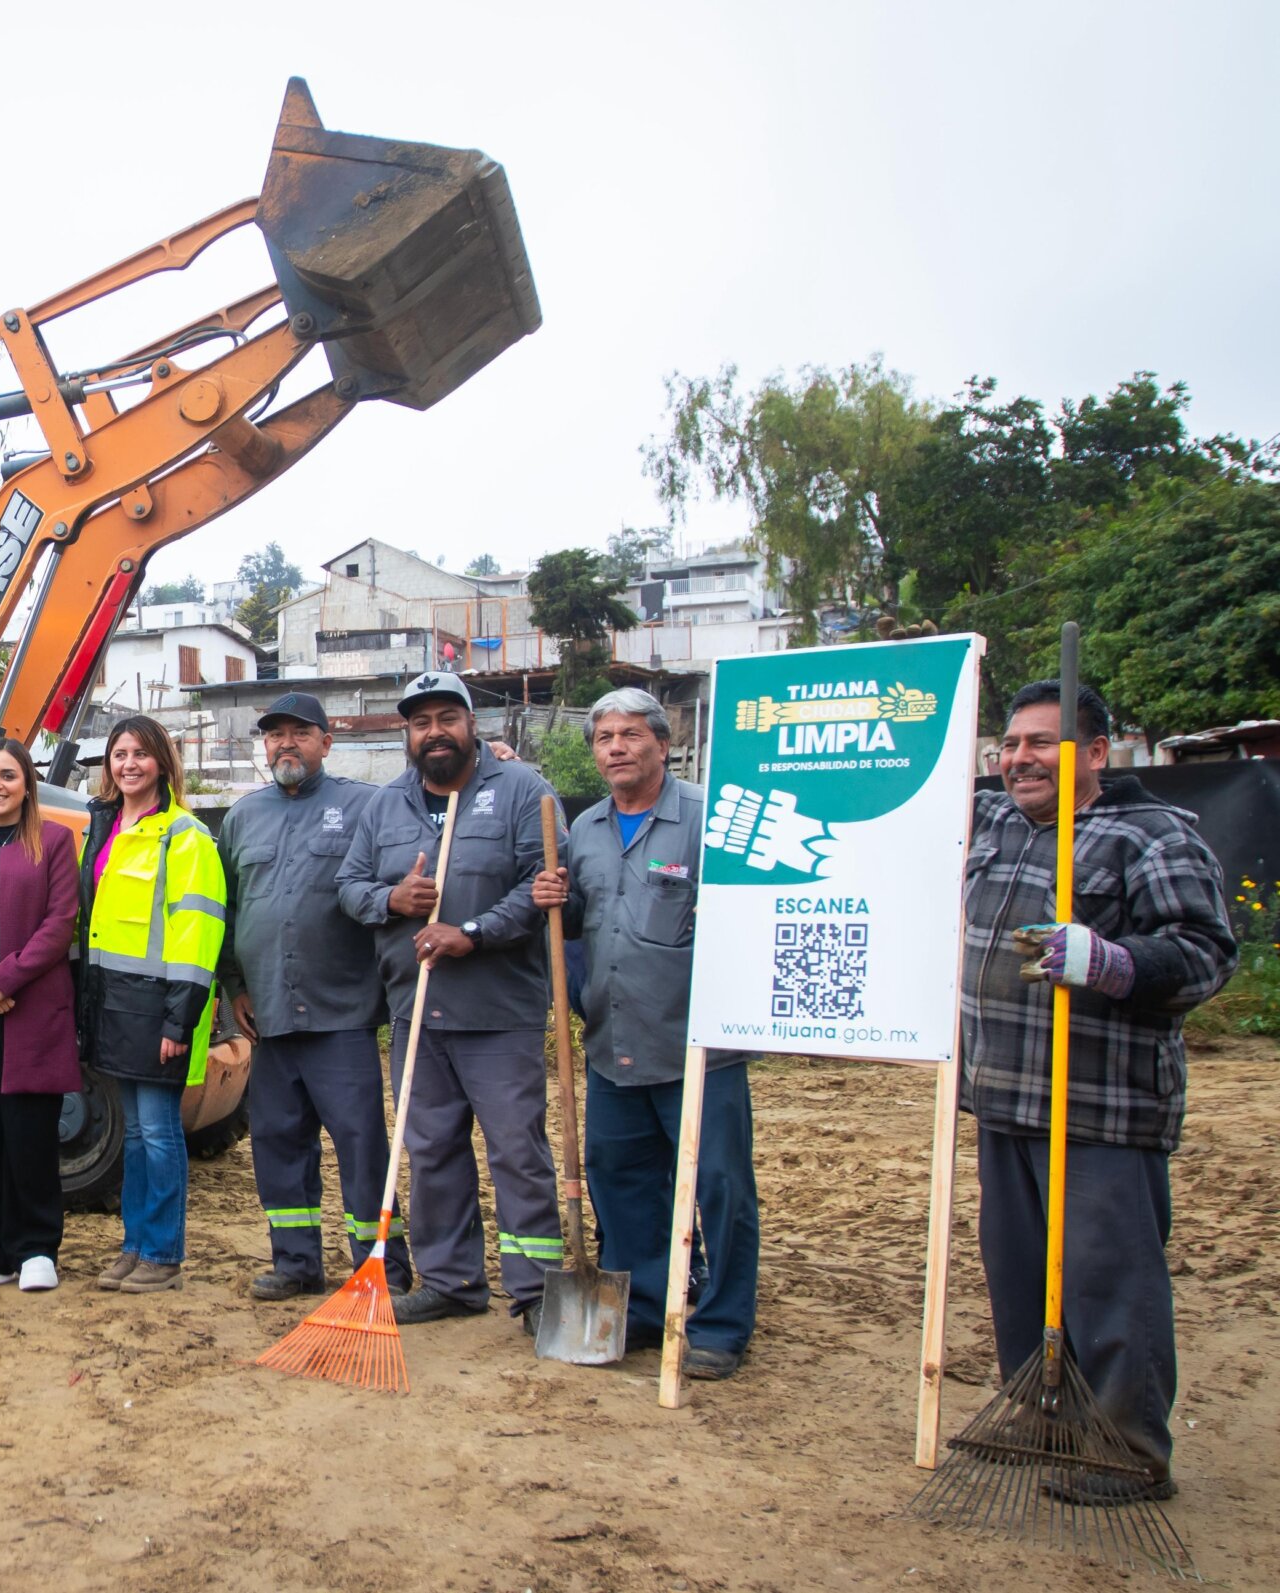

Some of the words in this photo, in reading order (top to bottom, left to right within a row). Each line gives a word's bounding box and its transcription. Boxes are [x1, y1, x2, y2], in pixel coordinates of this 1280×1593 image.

[787, 680, 879, 700] TIJUANA
[799, 701, 871, 719] CIUDAD
[777, 721, 896, 755] LIMPIA
[758, 763, 770, 773] ES
[771, 760, 857, 772] RESPONSABILIDAD
[859, 759, 873, 769] DE
[874, 758, 910, 768] TODOS
[775, 898, 869, 914] ESCANEA
[721, 1022, 919, 1043] www.tijuana.gob.mx
